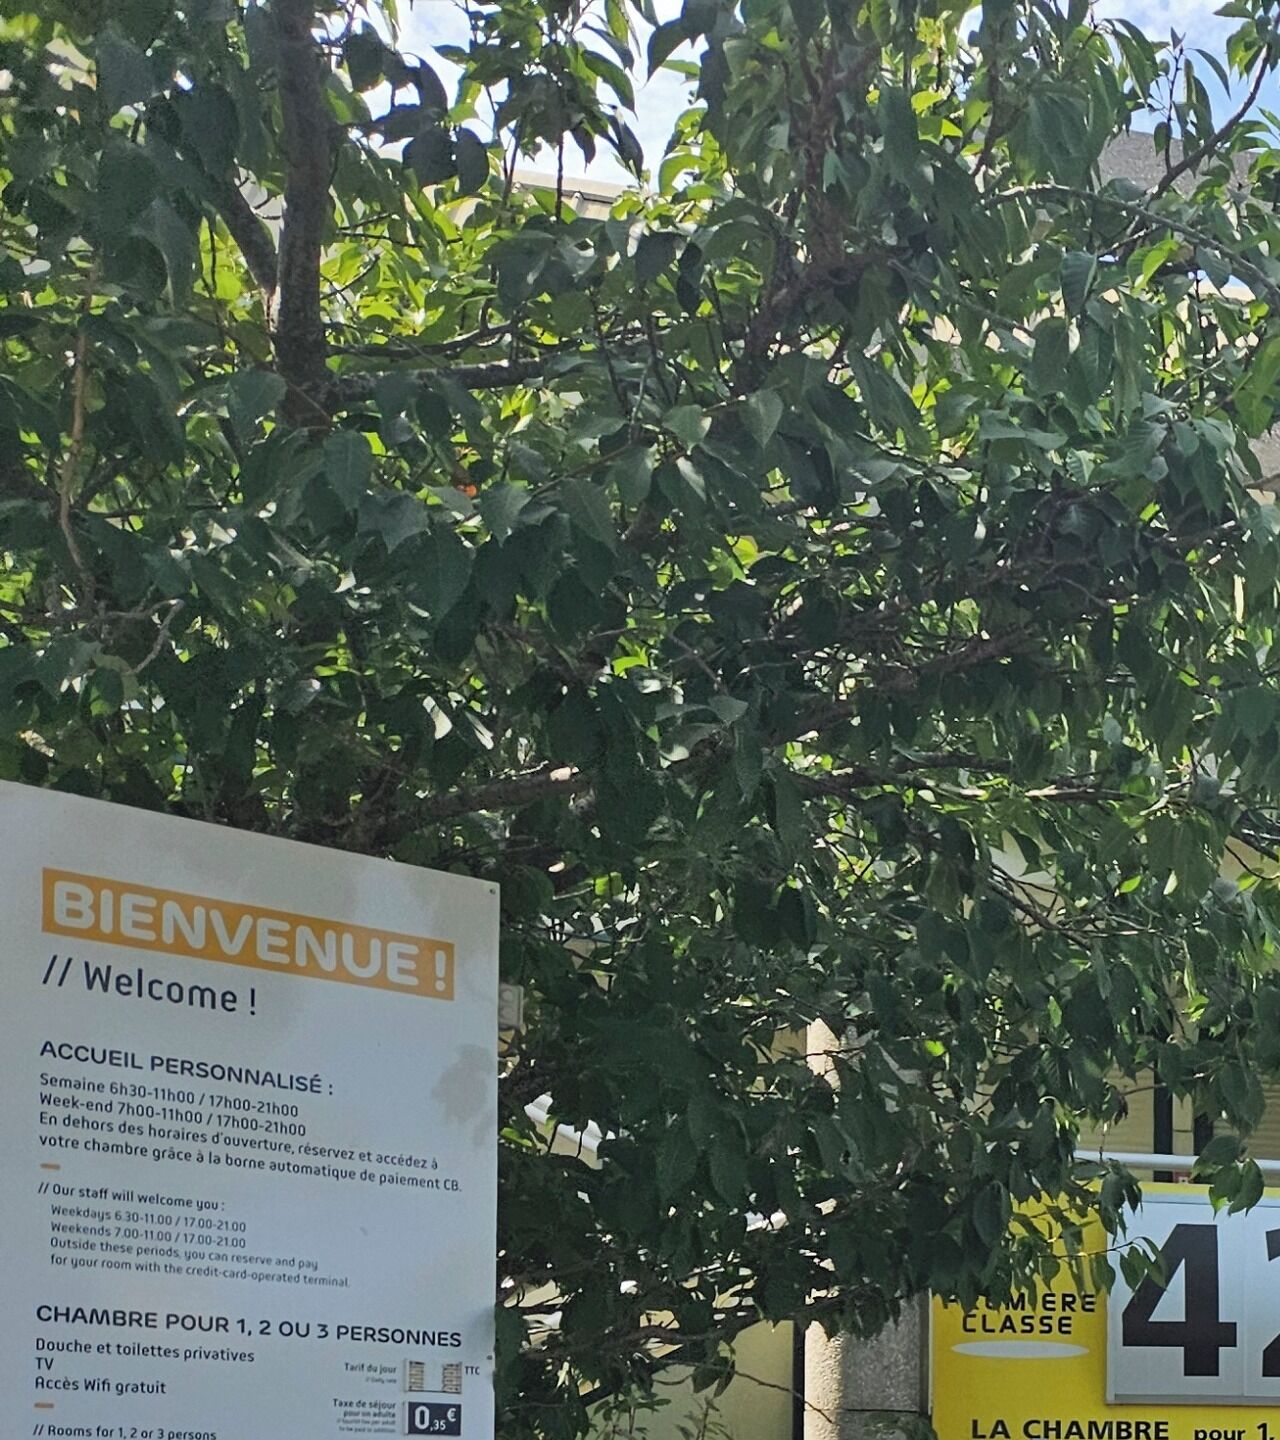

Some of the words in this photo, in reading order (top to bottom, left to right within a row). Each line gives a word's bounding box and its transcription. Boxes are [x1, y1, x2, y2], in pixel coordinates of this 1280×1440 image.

[54, 880, 419, 986] BIENVENUE
[84, 960, 237, 1012] Welcome
[40, 1040, 143, 1070] ACCUEIL
[150, 1055, 322, 1094] PERSONNALISÉ
[40, 1073, 105, 1094] Semaine
[109, 1082, 195, 1104] 6h30-11h00
[209, 1094, 298, 1117] 17h00-21h00
[40, 1092, 113, 1113] Week-end
[117, 1102, 203, 1124] 7h00-11h00
[217, 1114, 306, 1137] 17h00-21h00
[39, 1112, 58, 1126] En
[62, 1116, 114, 1134] dehors
[118, 1121, 144, 1136] des
[148, 1124, 208, 1143] horaires
[211, 1131, 295, 1155] d'ouverture,
[298, 1143, 355, 1160] réservez
[358, 1151, 373, 1162] et
[376, 1153, 428, 1169] accédez
[431, 1158, 438, 1170] à
[39, 1135, 80, 1149] votre
[84, 1138, 148, 1157] chambre
[152, 1147, 192, 1162] grâce
[196, 1150, 204, 1163] à
[208, 1152, 221, 1165] la
[225, 1155, 265, 1170] borne
[269, 1160, 356, 1181] automatique
[360, 1169, 376, 1182] de
[379, 1173, 440, 1190] paiement
[443, 1179, 462, 1192] CB.
[53, 1184, 76, 1197] Our
[79, 1187, 108, 1200] staff
[112, 1189, 134, 1202] will
[137, 1192, 193, 1208] welcome
[196, 1200, 219, 1211] you
[51, 1204, 111, 1221] Weekdays
[50, 1221, 112, 1237] Weekends
[50, 1237, 96, 1251] Outside
[100, 1242, 133, 1254] these
[184, 1250, 205, 1262] you
[208, 1251, 228, 1262] can
[231, 1254, 272, 1266] reserve
[275, 1257, 295, 1268] and
[298, 1260, 318, 1271] pay
[50, 1254, 67, 1266] for
[71, 1257, 98, 1269] your
[101, 1259, 131, 1270] room
[135, 1260, 160, 1273] with
[164, 1263, 183, 1274] the
[36, 1304, 158, 1328] CHAMBRE
[166, 1314, 229, 1332] POUR
[236, 1319, 252, 1336] 1,
[259, 1320, 271, 1335] 2
[279, 1321, 310, 1337] OU
[317, 1324, 329, 1338] 3
[337, 1325, 462, 1347] PERSONNES
[962, 1314, 1072, 1335] CLASSE
[36, 1338, 92, 1353] Douche
[96, 1343, 112, 1354] et
[116, 1343, 179, 1358] toilettes
[184, 1347, 254, 1362] privatives
[36, 1357, 54, 1370] TV
[35, 1376, 79, 1390] Accès
[84, 1378, 111, 1392] Wifi
[115, 1380, 166, 1395] gratuit
[48, 1425, 92, 1437] Rooms
[96, 1425, 113, 1437] for
[140, 1430, 153, 1438] or
[971, 1419, 1011, 1440] LA
[1023, 1419, 1170, 1440] CHAMBRE
